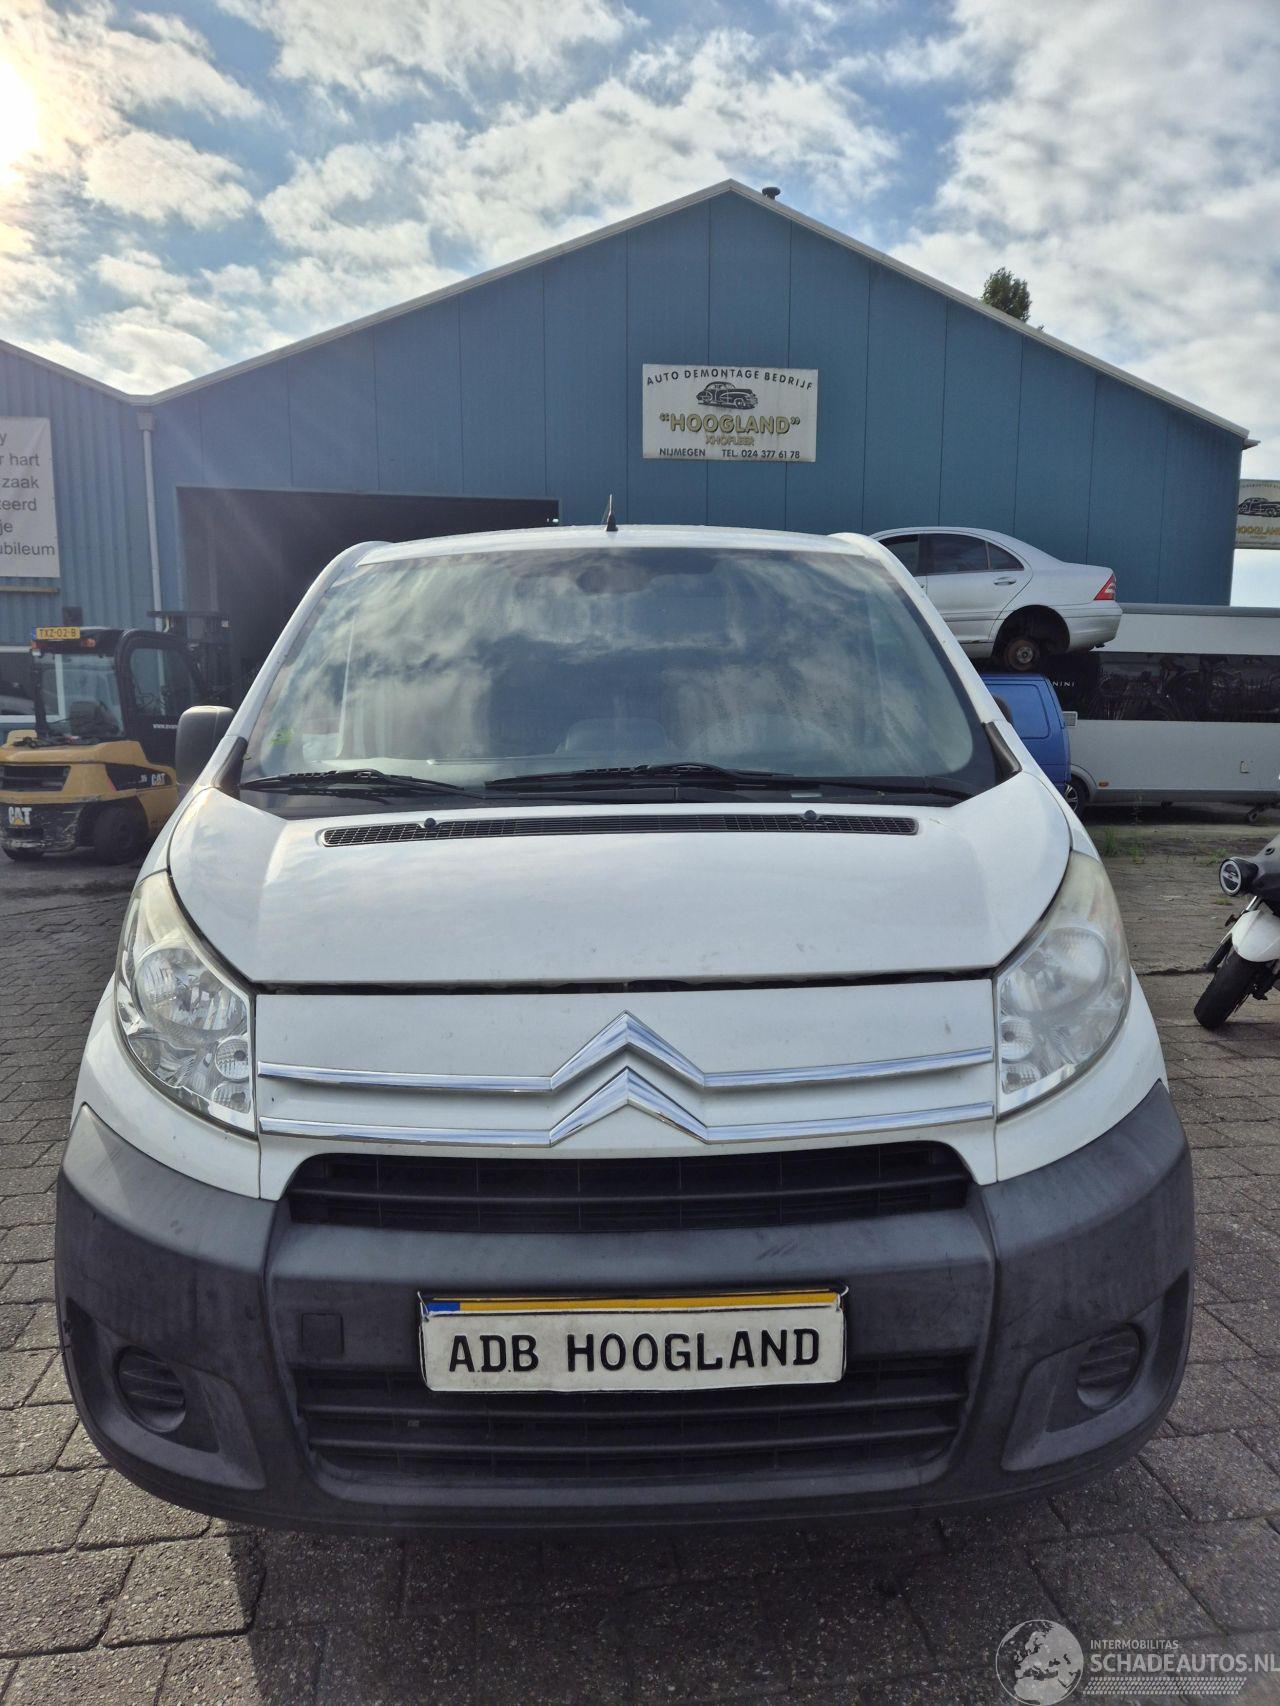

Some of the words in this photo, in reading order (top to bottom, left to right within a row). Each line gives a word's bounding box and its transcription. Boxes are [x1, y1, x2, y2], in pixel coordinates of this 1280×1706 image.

[647, 371, 679, 386] AUTO
[684, 368, 760, 380] DEMONTAGE
[764, 372, 813, 390] BEDRIJF
[9, 452, 40, 467] hart
[659, 447, 706, 457] NIJMEGEN
[722, 449, 738, 458] TEL.
[741, 449, 758, 458] 024
[761, 450, 776, 459] 377
[778, 450, 787, 459] 61
[790, 450, 800, 459] 78
[2, 475, 40, 489] zaak
[0, 497, 37, 512] eerd
[151, 773, 166, 786] CAT
[8, 806, 33, 825] CAT
[566, 1327, 820, 1372] HOOGLAND
